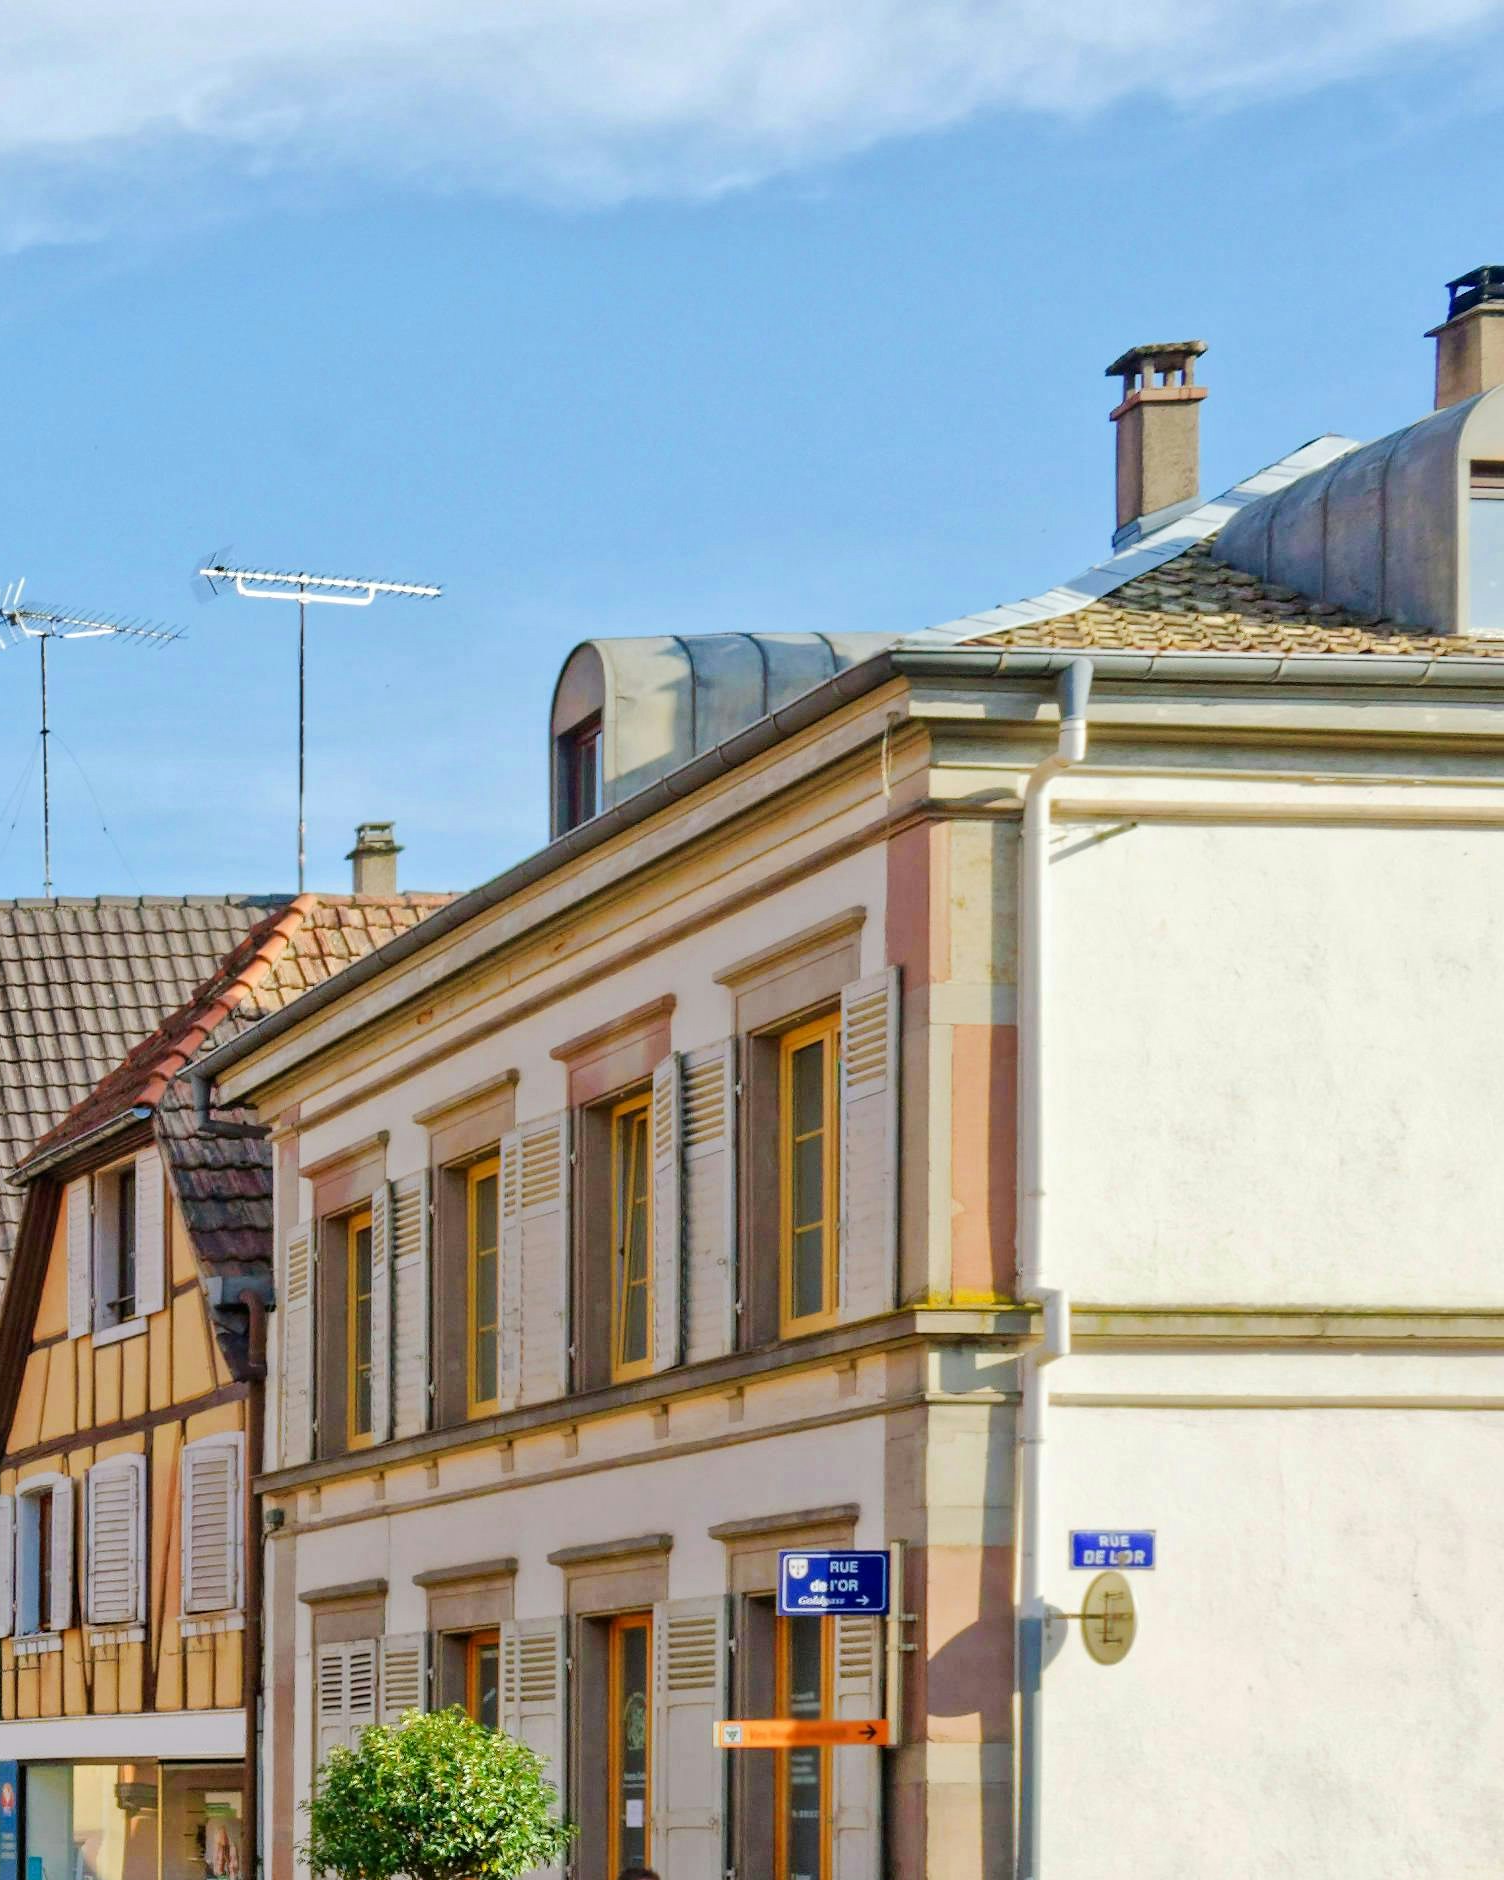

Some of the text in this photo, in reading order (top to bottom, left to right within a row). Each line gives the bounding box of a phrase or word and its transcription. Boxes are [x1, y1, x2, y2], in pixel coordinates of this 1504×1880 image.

[1099, 1535, 1130, 1547] RUE
[1083, 1550, 1106, 1564] DE
[830, 1561, 858, 1573] RUE
[810, 1579, 828, 1593] de
